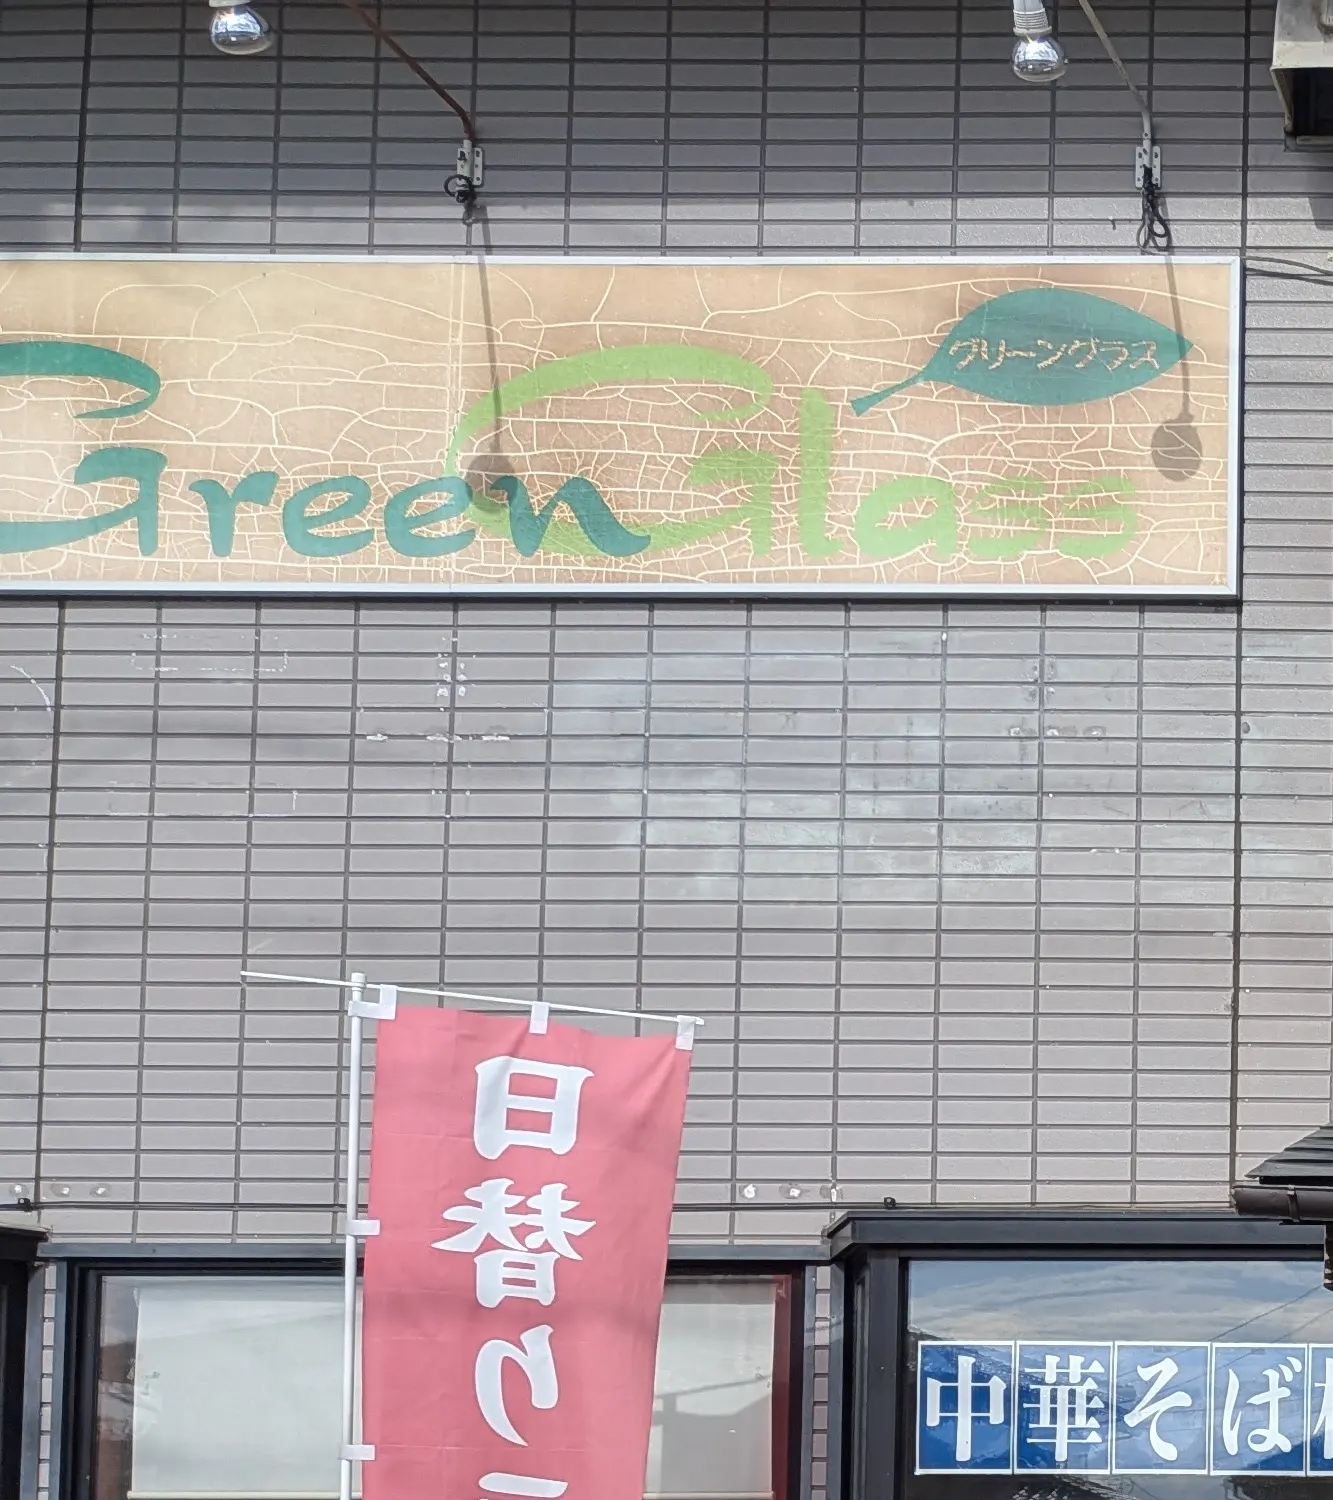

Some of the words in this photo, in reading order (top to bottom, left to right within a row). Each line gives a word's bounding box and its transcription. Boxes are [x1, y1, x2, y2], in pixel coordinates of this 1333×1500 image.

[949, 337, 1161, 372] グリーングラス
[450, 343, 1139, 559] Glass
